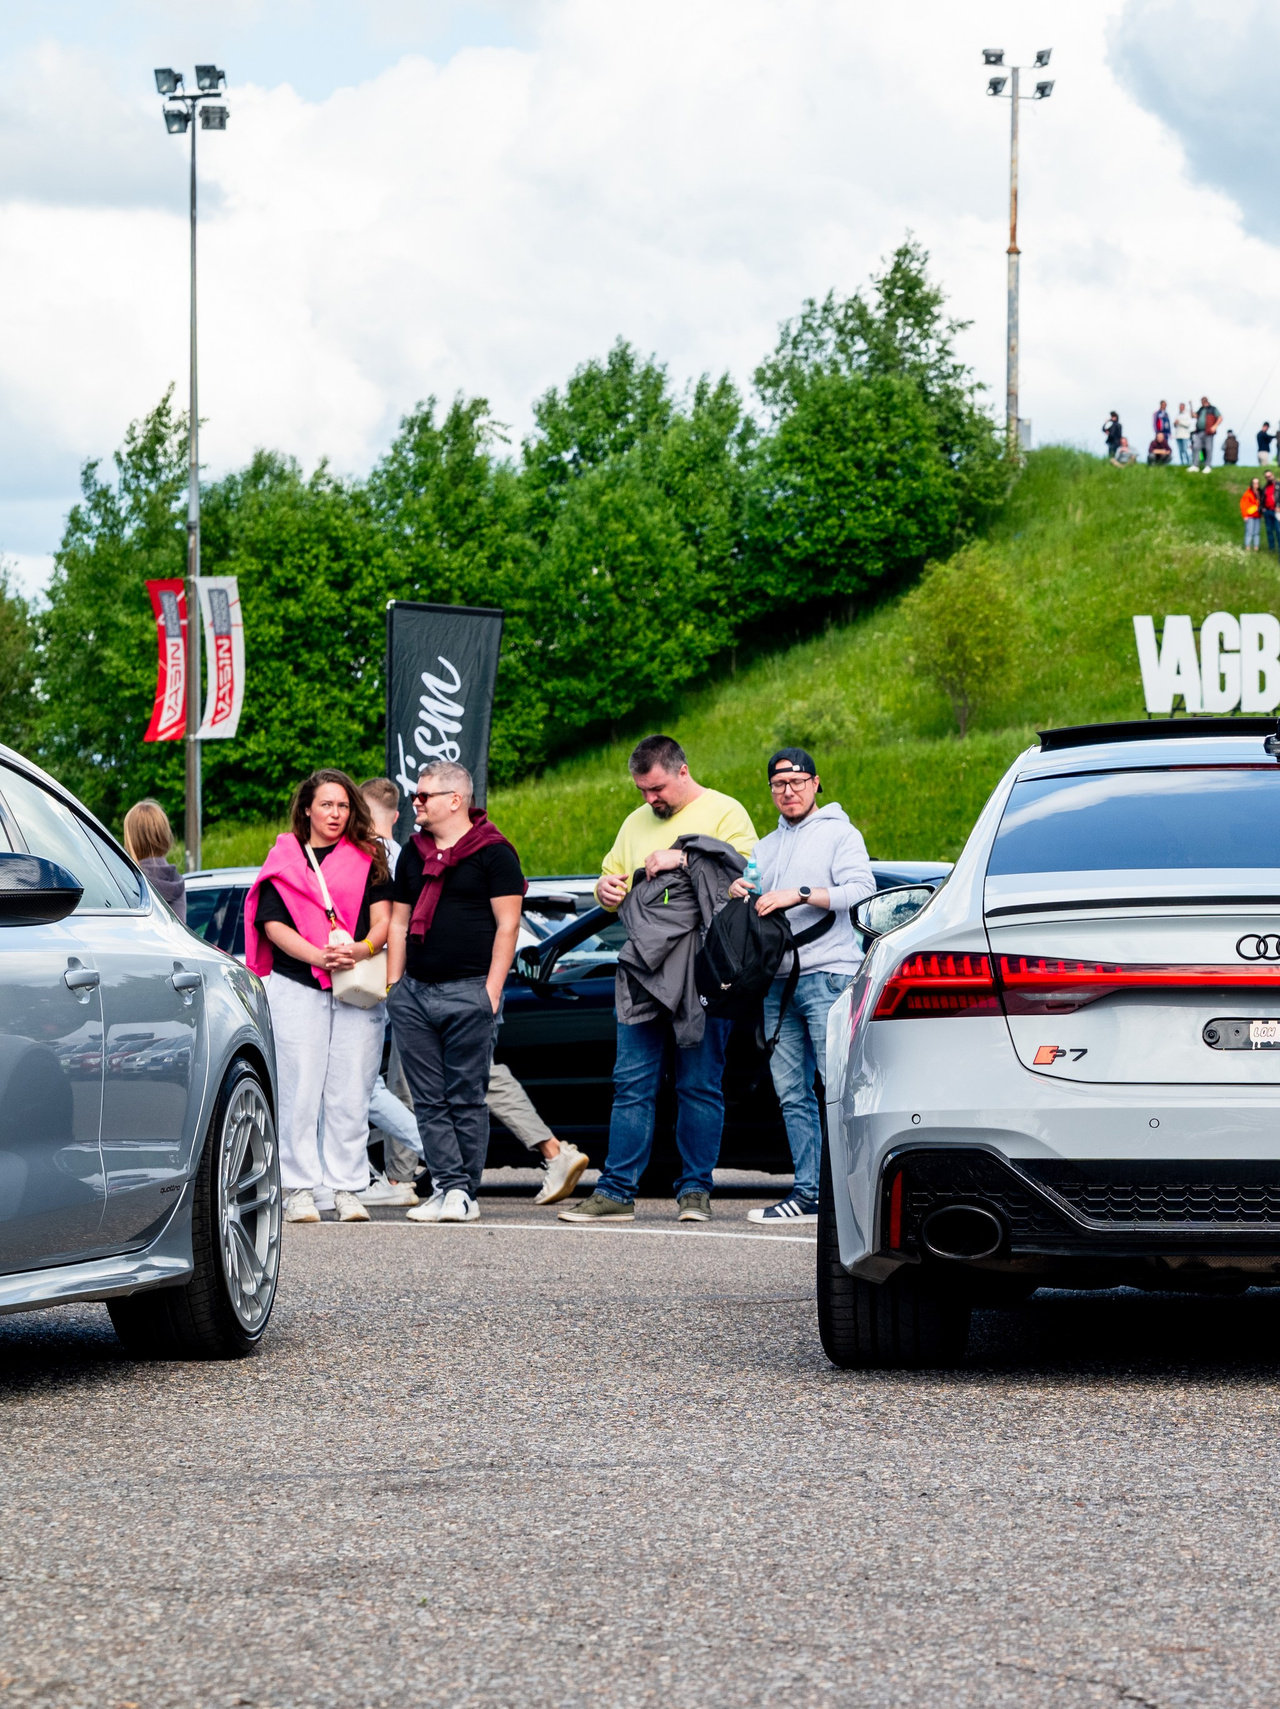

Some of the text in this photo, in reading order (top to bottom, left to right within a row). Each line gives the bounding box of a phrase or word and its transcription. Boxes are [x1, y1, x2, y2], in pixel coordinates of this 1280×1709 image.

[213, 638, 232, 722] VASIN
[1253, 1026, 1276, 1038] LOW
[160, 1184, 181, 1195] quattro
